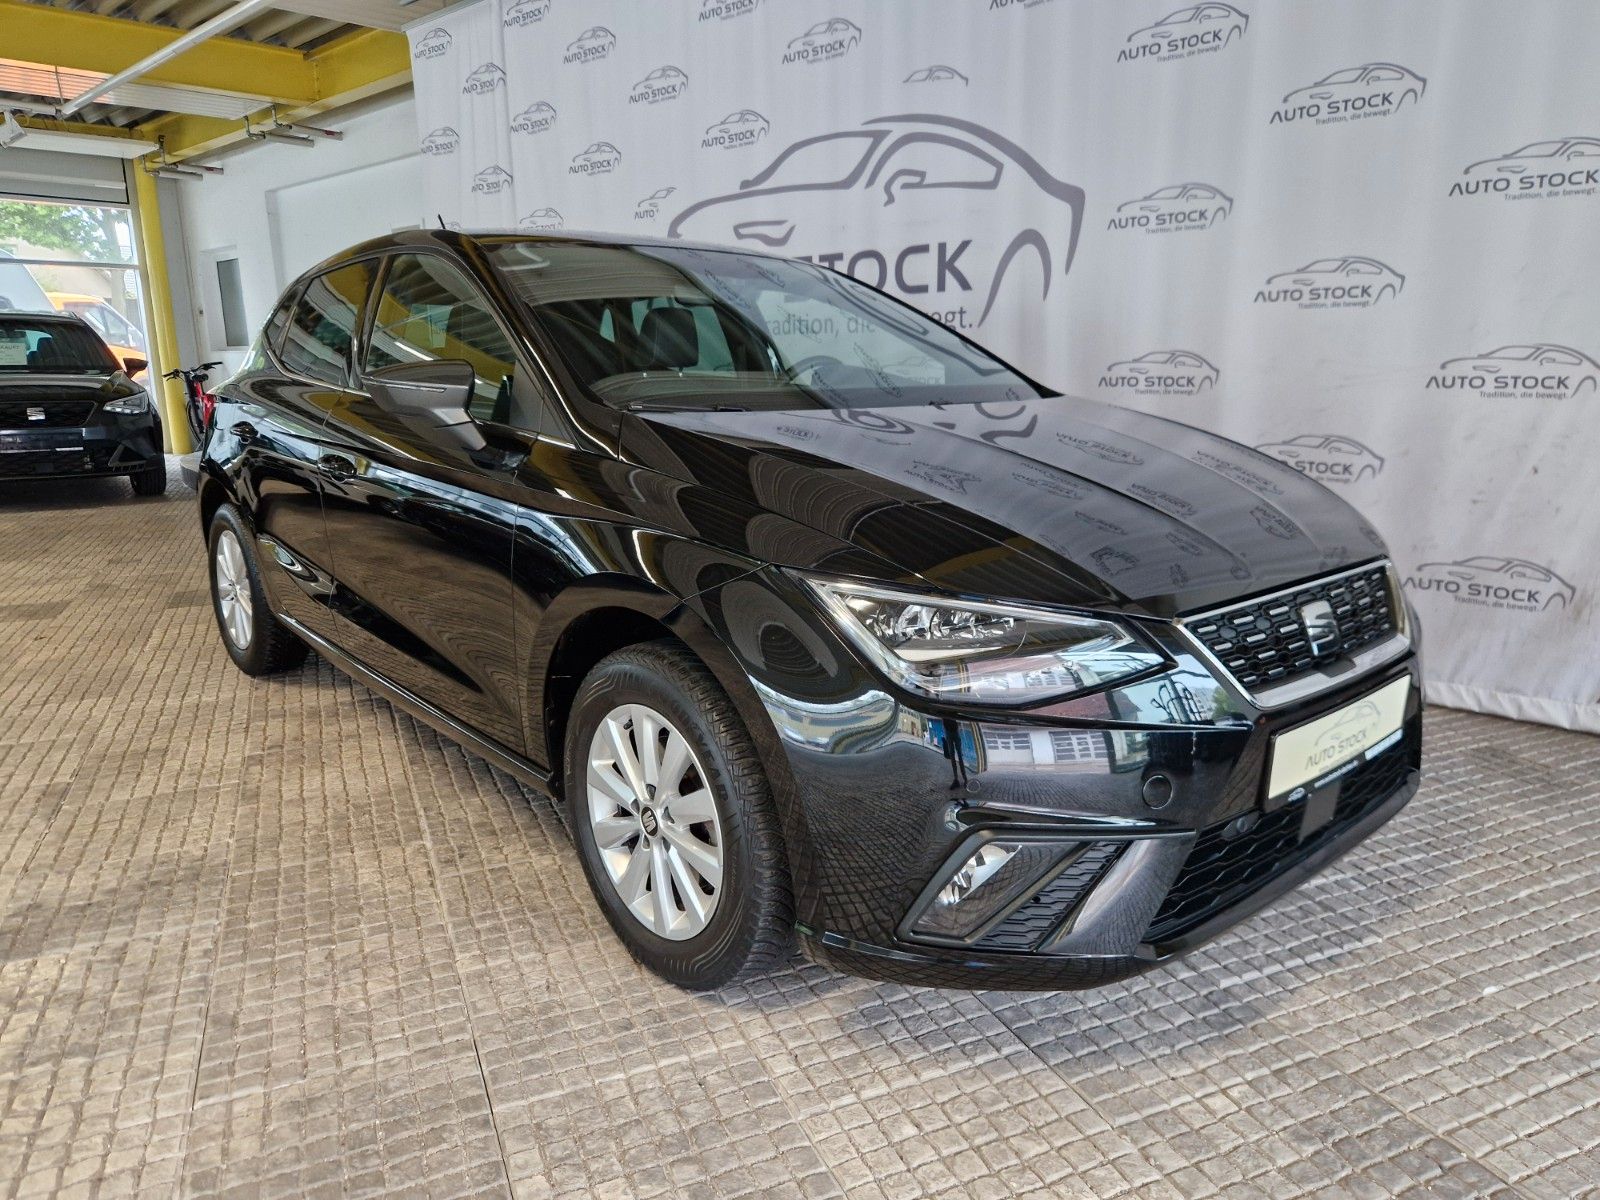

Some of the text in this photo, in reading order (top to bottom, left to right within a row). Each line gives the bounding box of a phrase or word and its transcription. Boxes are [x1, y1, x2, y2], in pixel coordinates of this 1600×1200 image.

[503, 15, 521, 28] AUTO
[698, 6, 723, 22] AUTO
[563, 52, 583, 64] AUTO
[583, 44, 606, 58] STOCK
[782, 50, 810, 65] AUTO
[811, 40, 846, 57] STOCK
[1117, 29, 1222, 62] AUTO STOCK
[629, 91, 650, 104] AUTO
[651, 84, 678, 98] STOCK
[1269, 91, 1394, 124] AUTO STOCK
[1315, 115, 1349, 125] Tradition,
[1350, 113, 1362, 121] die
[701, 135, 726, 148] AUTO
[728, 129, 756, 143] STOCK
[568, 162, 589, 174] AUTO
[590, 158, 612, 171] STOCK
[1448, 169, 1599, 197] AUTO STOCK
[1504, 192, 1543, 200] Tradition,
[634, 209, 655, 220] AUTO
[1106, 209, 1208, 231] AUTO STOCK
[1253, 285, 1372, 303] AUTO STOCK
[1098, 376, 1195, 388] AUTO STOCK
[1425, 375, 1570, 390] AUTO STOCK
[1479, 390, 1518, 399] Tradition,
[1519, 390, 1533, 399] die
[1294, 460, 1353, 476] STOCK
[1402, 577, 1540, 604] AUTO STOCK
[1454, 595, 1490, 607] Tradition,
[1491, 600, 1504, 609] die
[1304, 745, 1336, 771] AUTO
